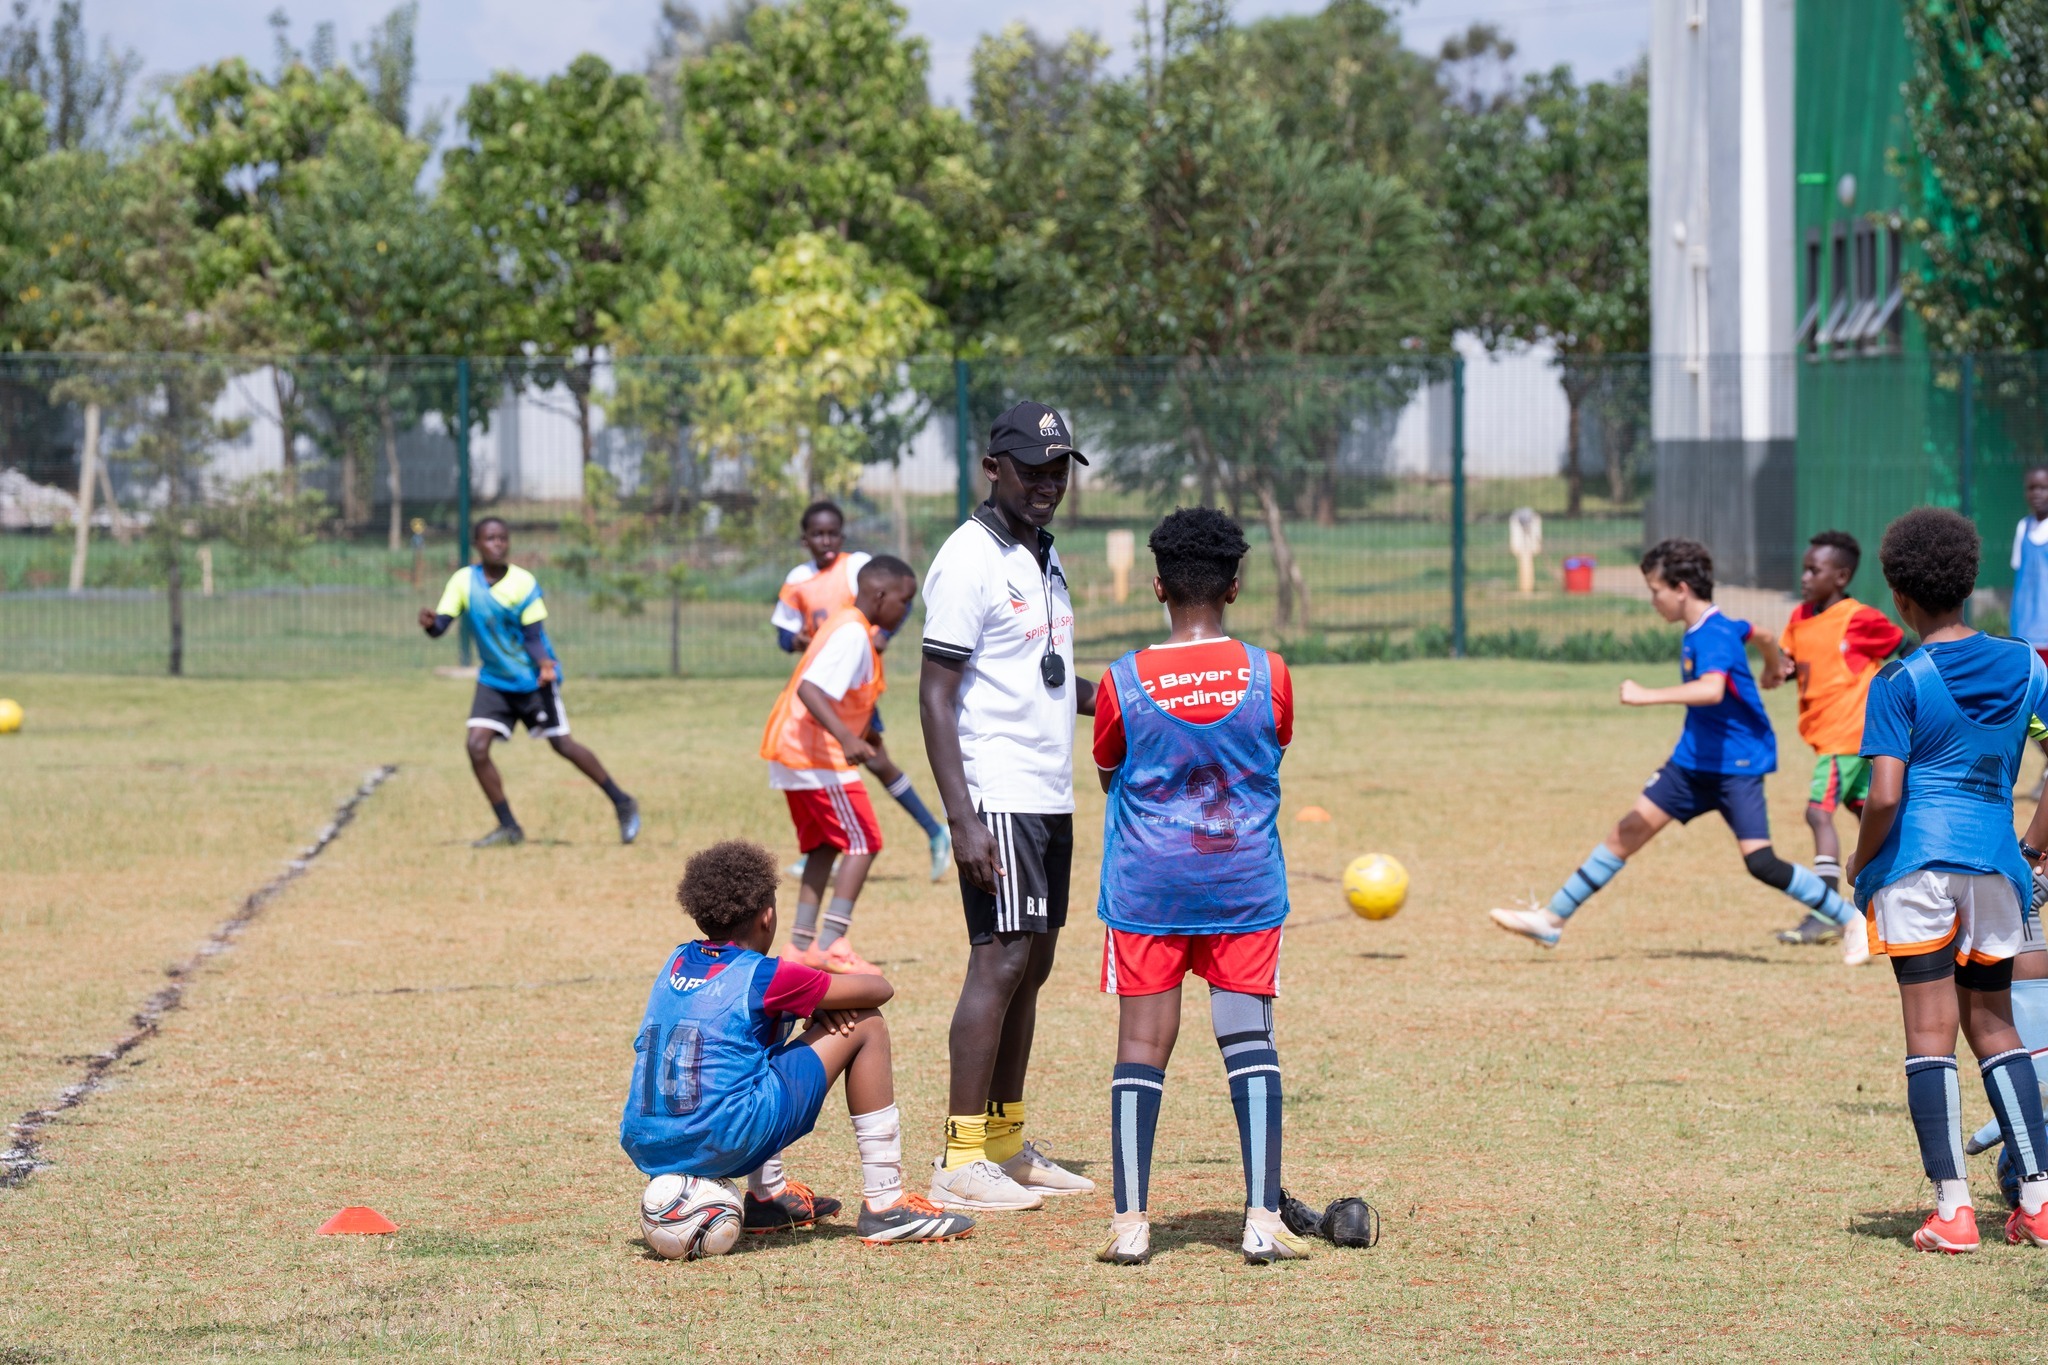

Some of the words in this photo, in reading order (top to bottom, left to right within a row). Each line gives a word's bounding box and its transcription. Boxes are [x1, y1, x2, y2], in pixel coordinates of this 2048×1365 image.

[1040, 428, 1061, 437] CDA
[1159, 670, 1232, 689] Bayer
[1953, 753, 2007, 804] 4
[1186, 763, 1239, 855] 3
[633, 1023, 704, 1117] 10
